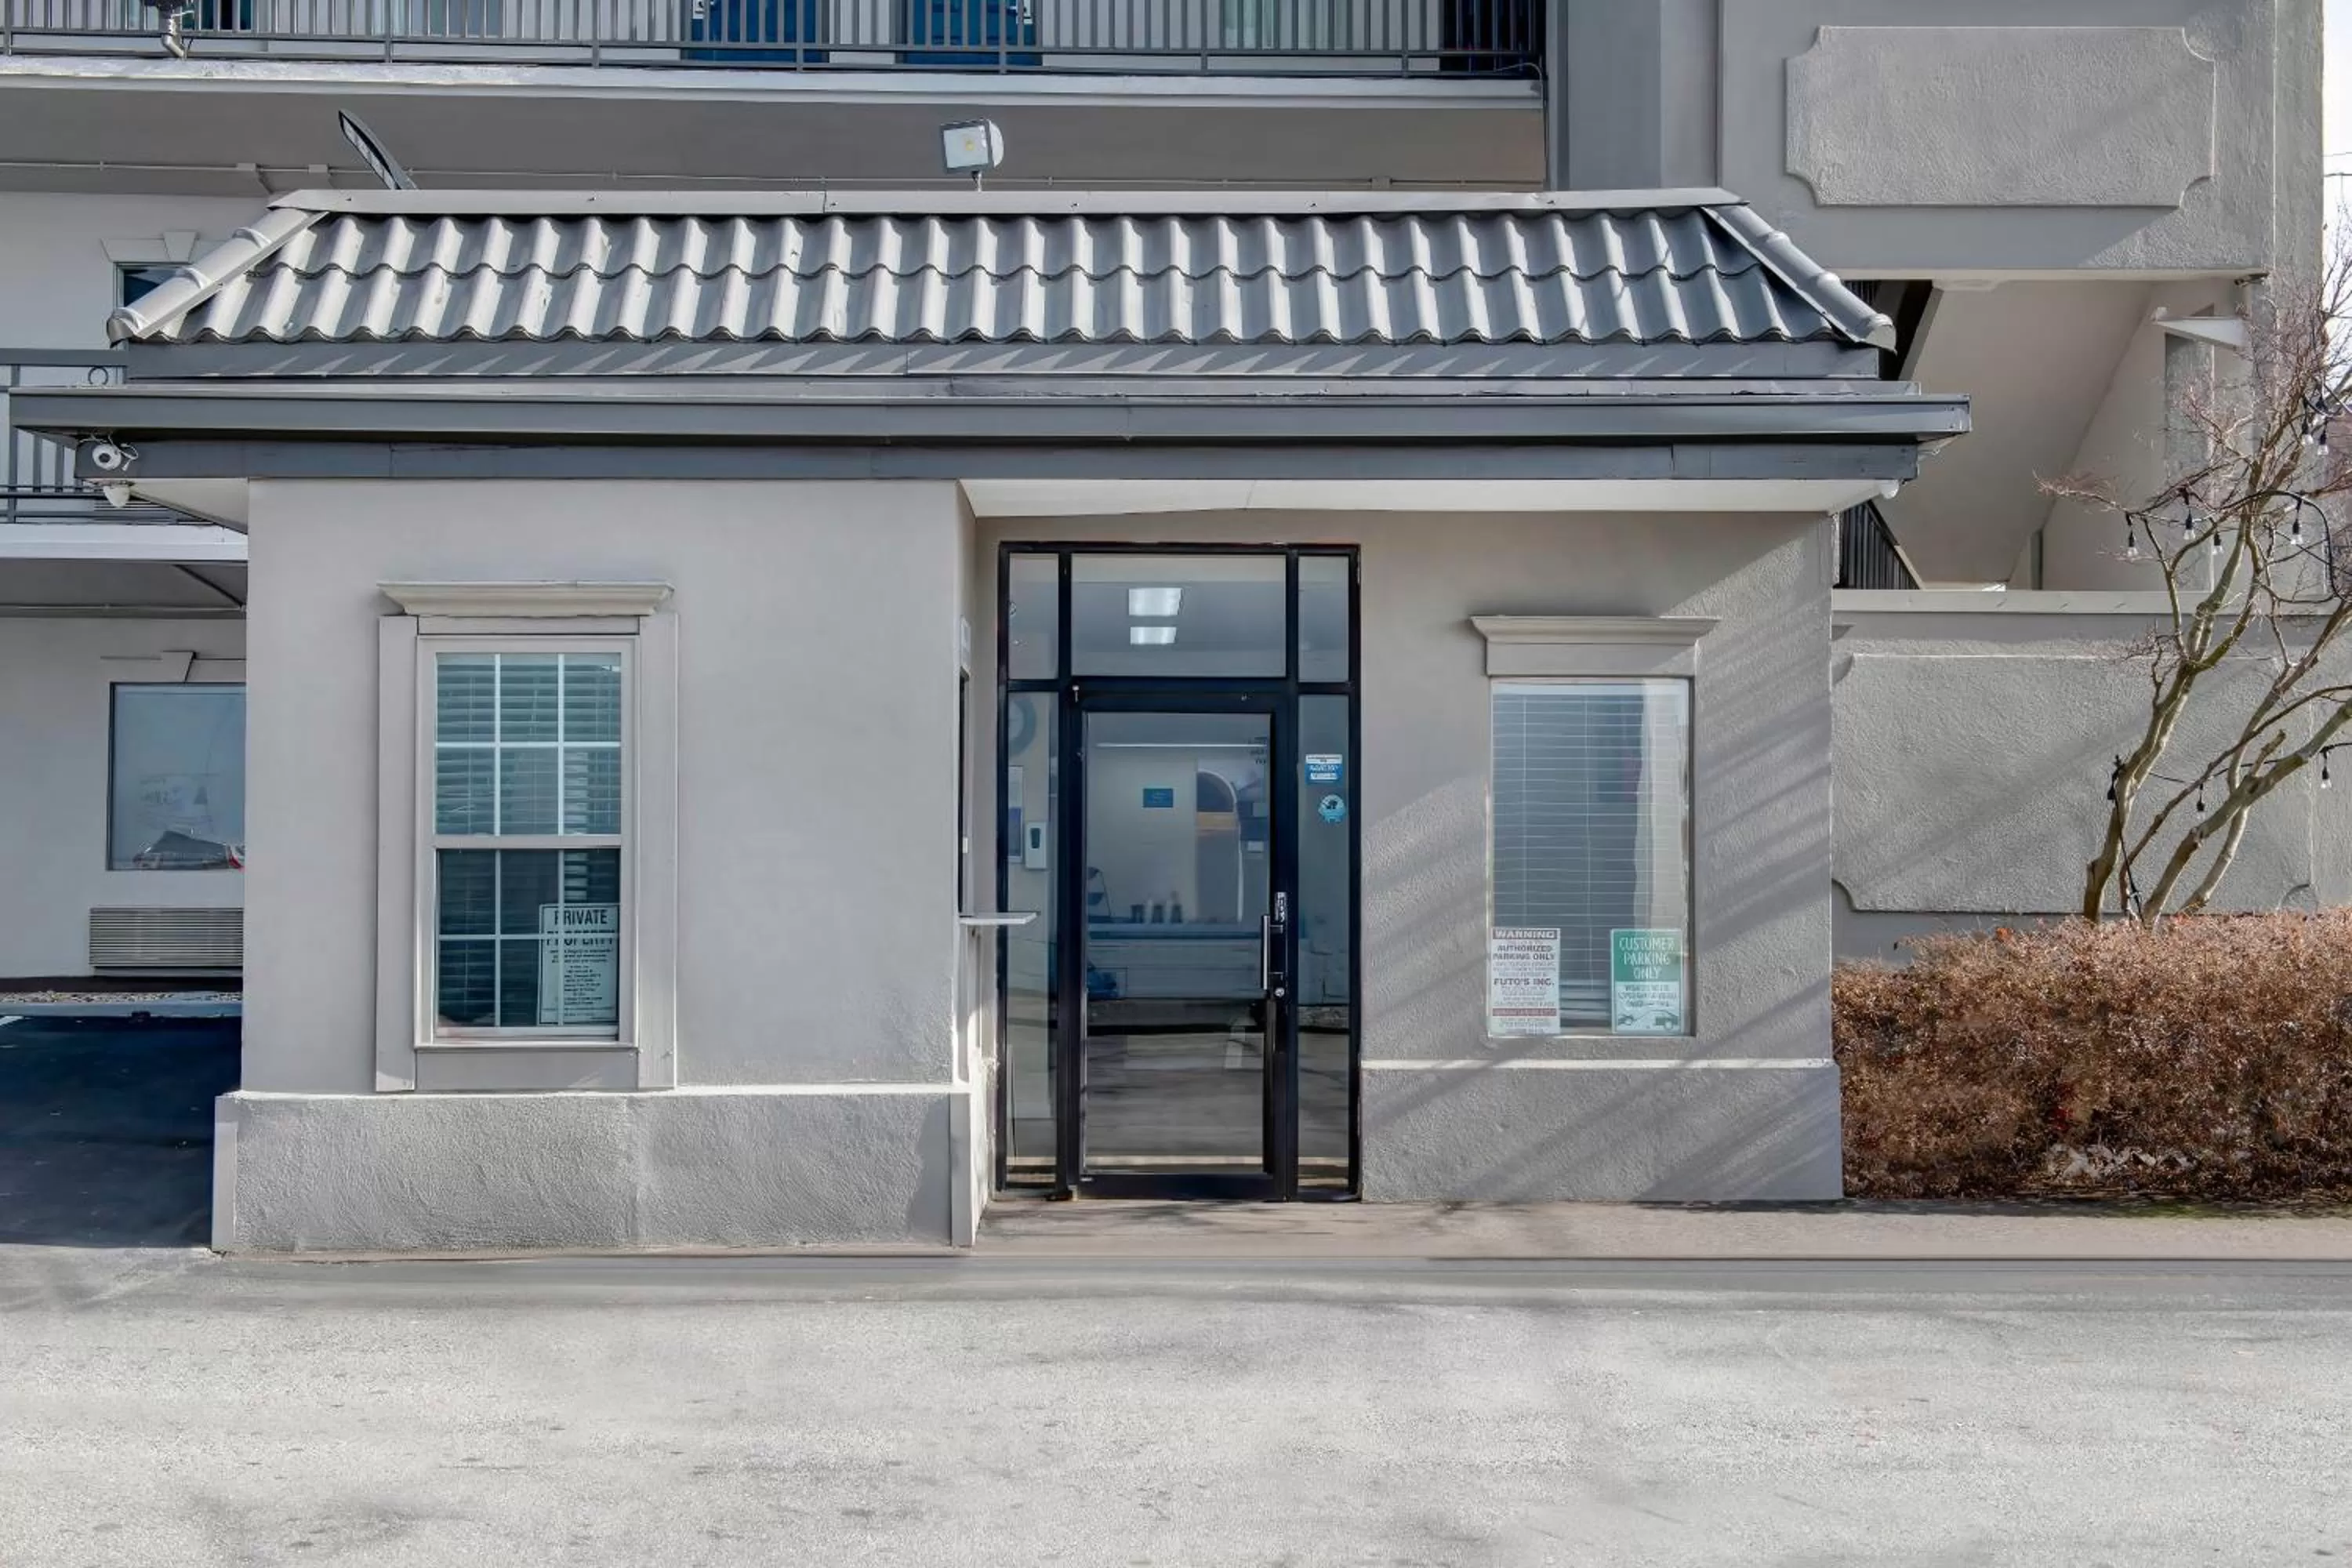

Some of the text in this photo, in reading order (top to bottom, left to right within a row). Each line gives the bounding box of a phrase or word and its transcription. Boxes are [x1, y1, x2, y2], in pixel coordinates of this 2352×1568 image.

[1496, 930, 1555, 938] WARNING
[1619, 937, 1675, 951] CUSTOMER
[1624, 951, 1670, 966] PARKING
[1633, 965, 1661, 979] ONLY
